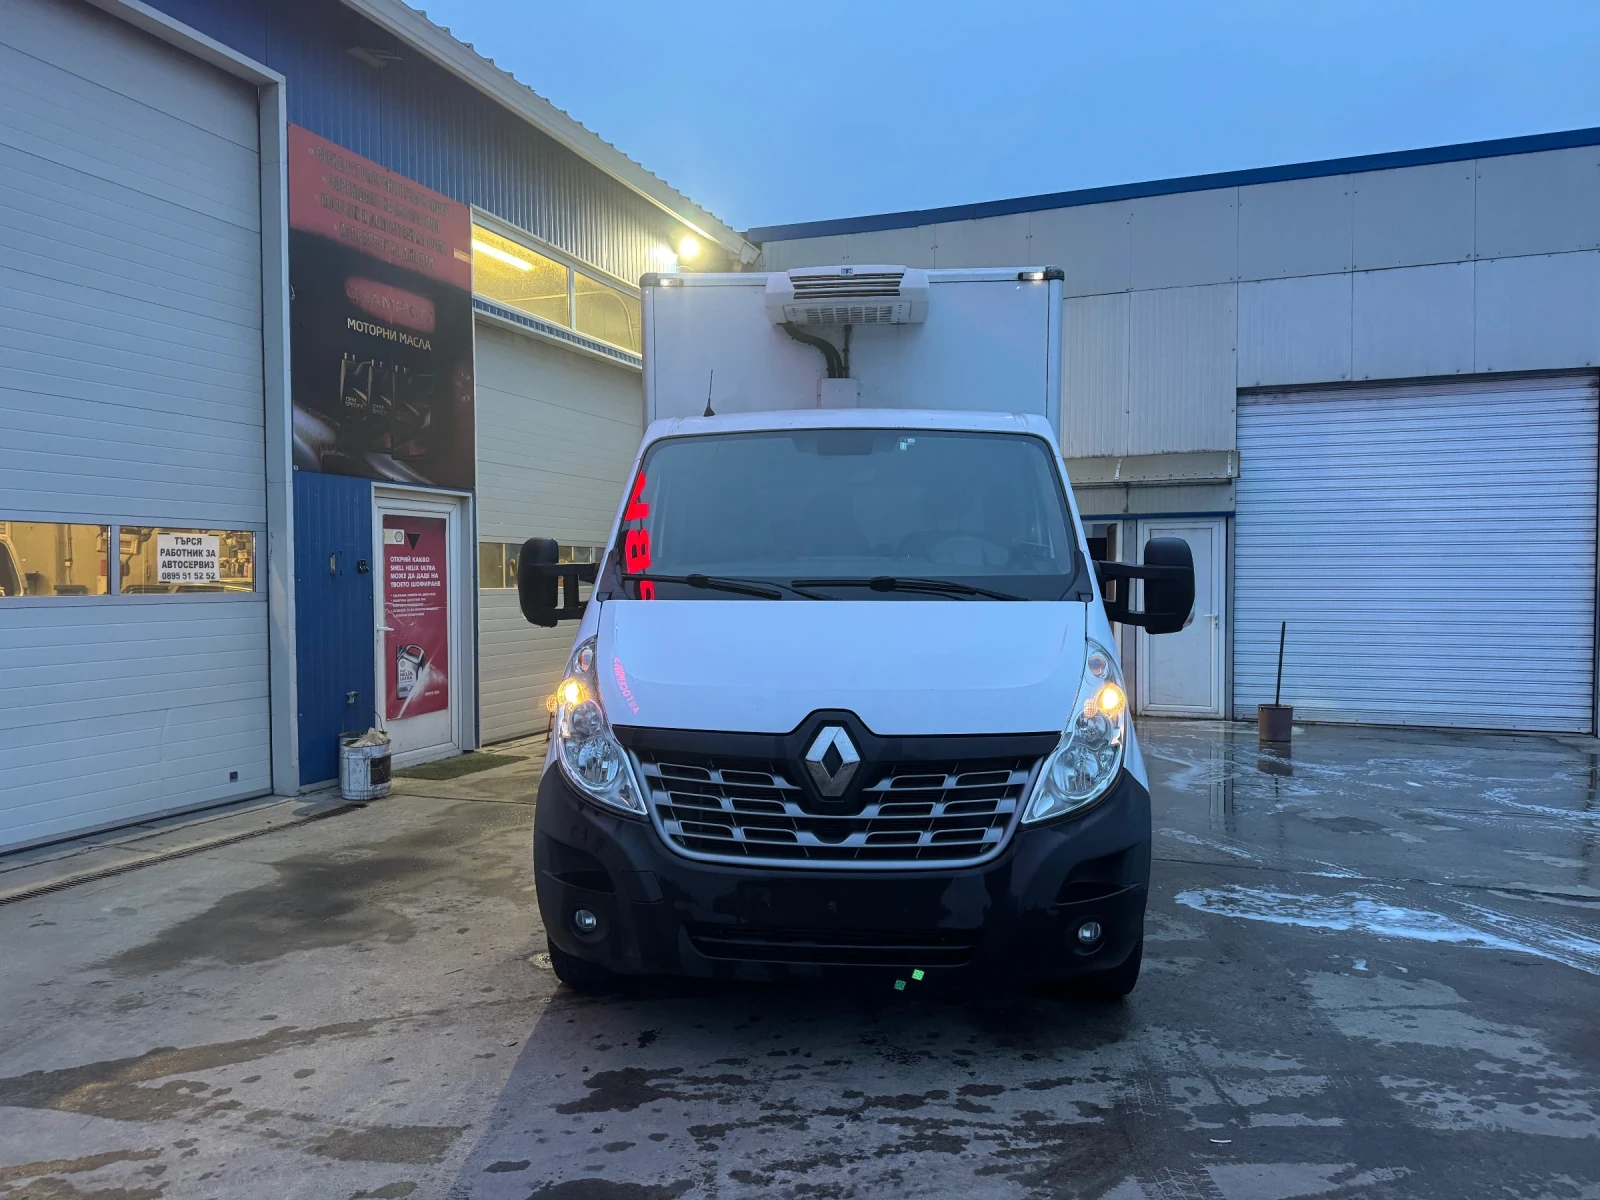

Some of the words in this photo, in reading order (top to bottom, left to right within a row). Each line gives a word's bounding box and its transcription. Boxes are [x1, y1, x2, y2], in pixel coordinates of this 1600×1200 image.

[347, 318, 397, 342] МОТОРНИ
[400, 332, 431, 351] МАСЛА
[174, 537, 202, 546] ТЪРСЯ
[160, 549, 203, 557] РАБОТНИК
[206, 549, 216, 557] ЗА
[162, 560, 215, 569] АВТОСЕРВИЗ
[194, 572, 204, 580] 52
[206, 572, 215, 580] 52
